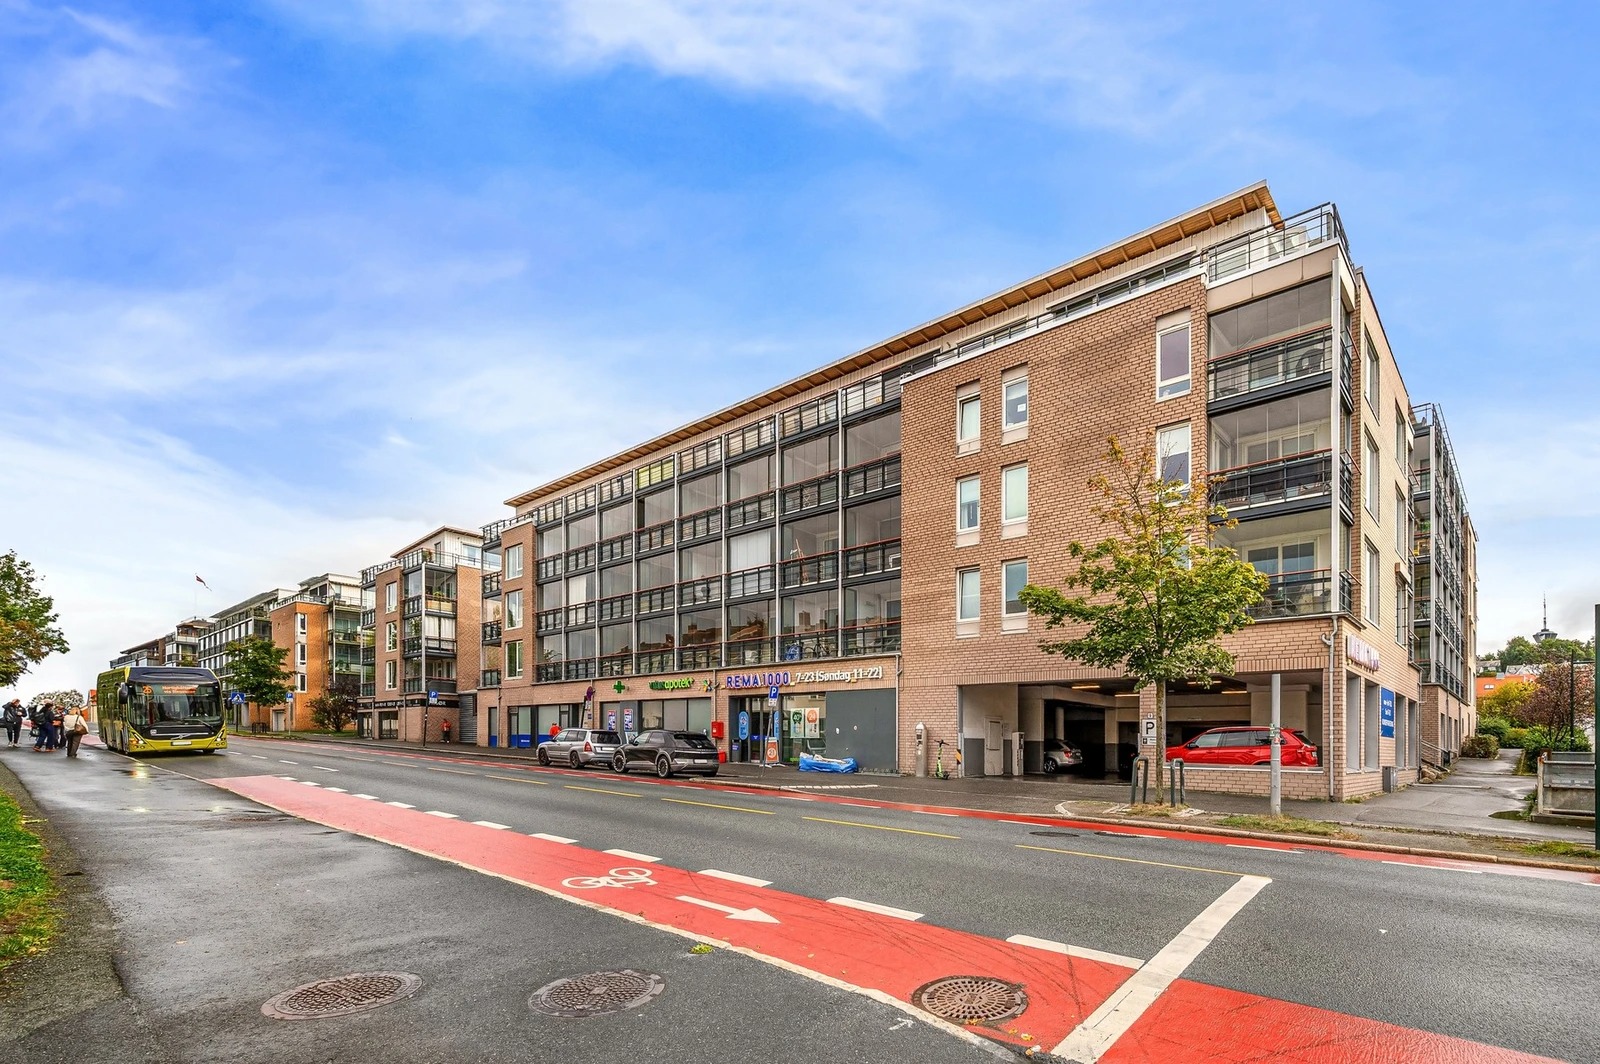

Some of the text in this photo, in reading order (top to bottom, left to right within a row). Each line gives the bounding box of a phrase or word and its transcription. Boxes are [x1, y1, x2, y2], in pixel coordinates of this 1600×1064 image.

[726, 671, 791, 689] REMA 1000
[795, 671, 815, 683] 7-23
[771, 687, 777, 697] P
[1145, 721, 1155, 735] P
